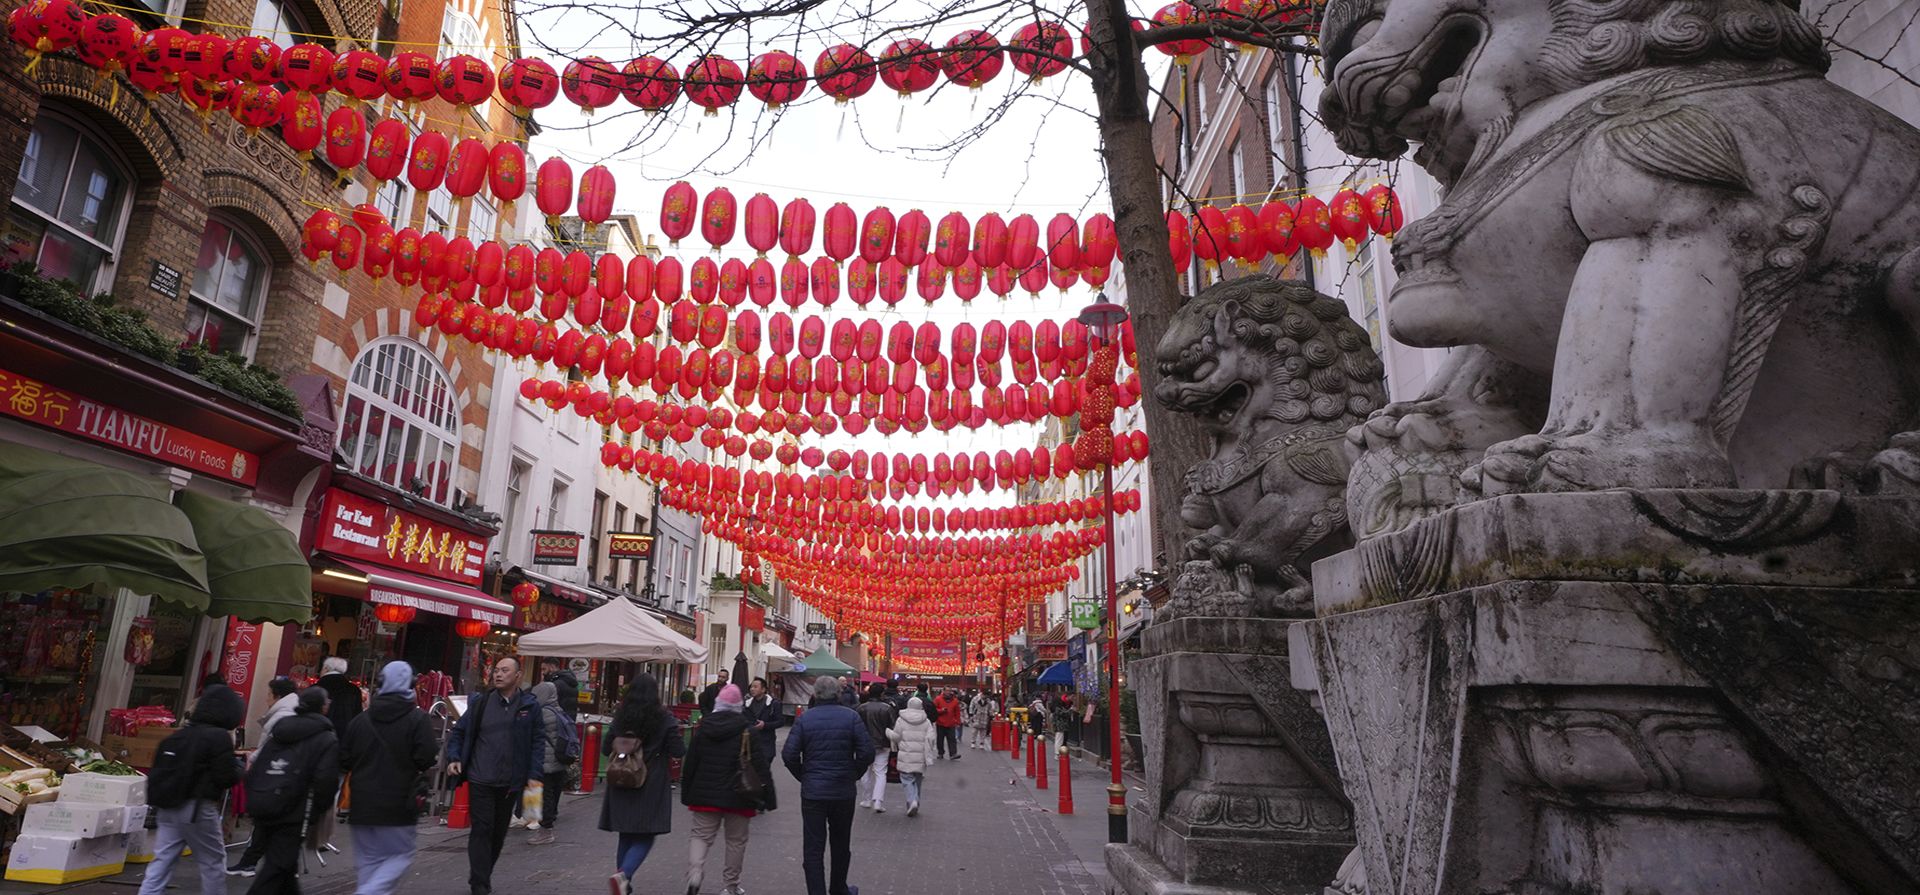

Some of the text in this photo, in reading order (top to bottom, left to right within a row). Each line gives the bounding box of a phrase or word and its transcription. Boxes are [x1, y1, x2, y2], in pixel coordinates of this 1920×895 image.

[76, 399, 227, 470] TIANFU Lucky Foods
[336, 504, 373, 528] Far East
[332, 523, 380, 548] Restaurant
[370, 588, 403, 606] BREAKFAST
